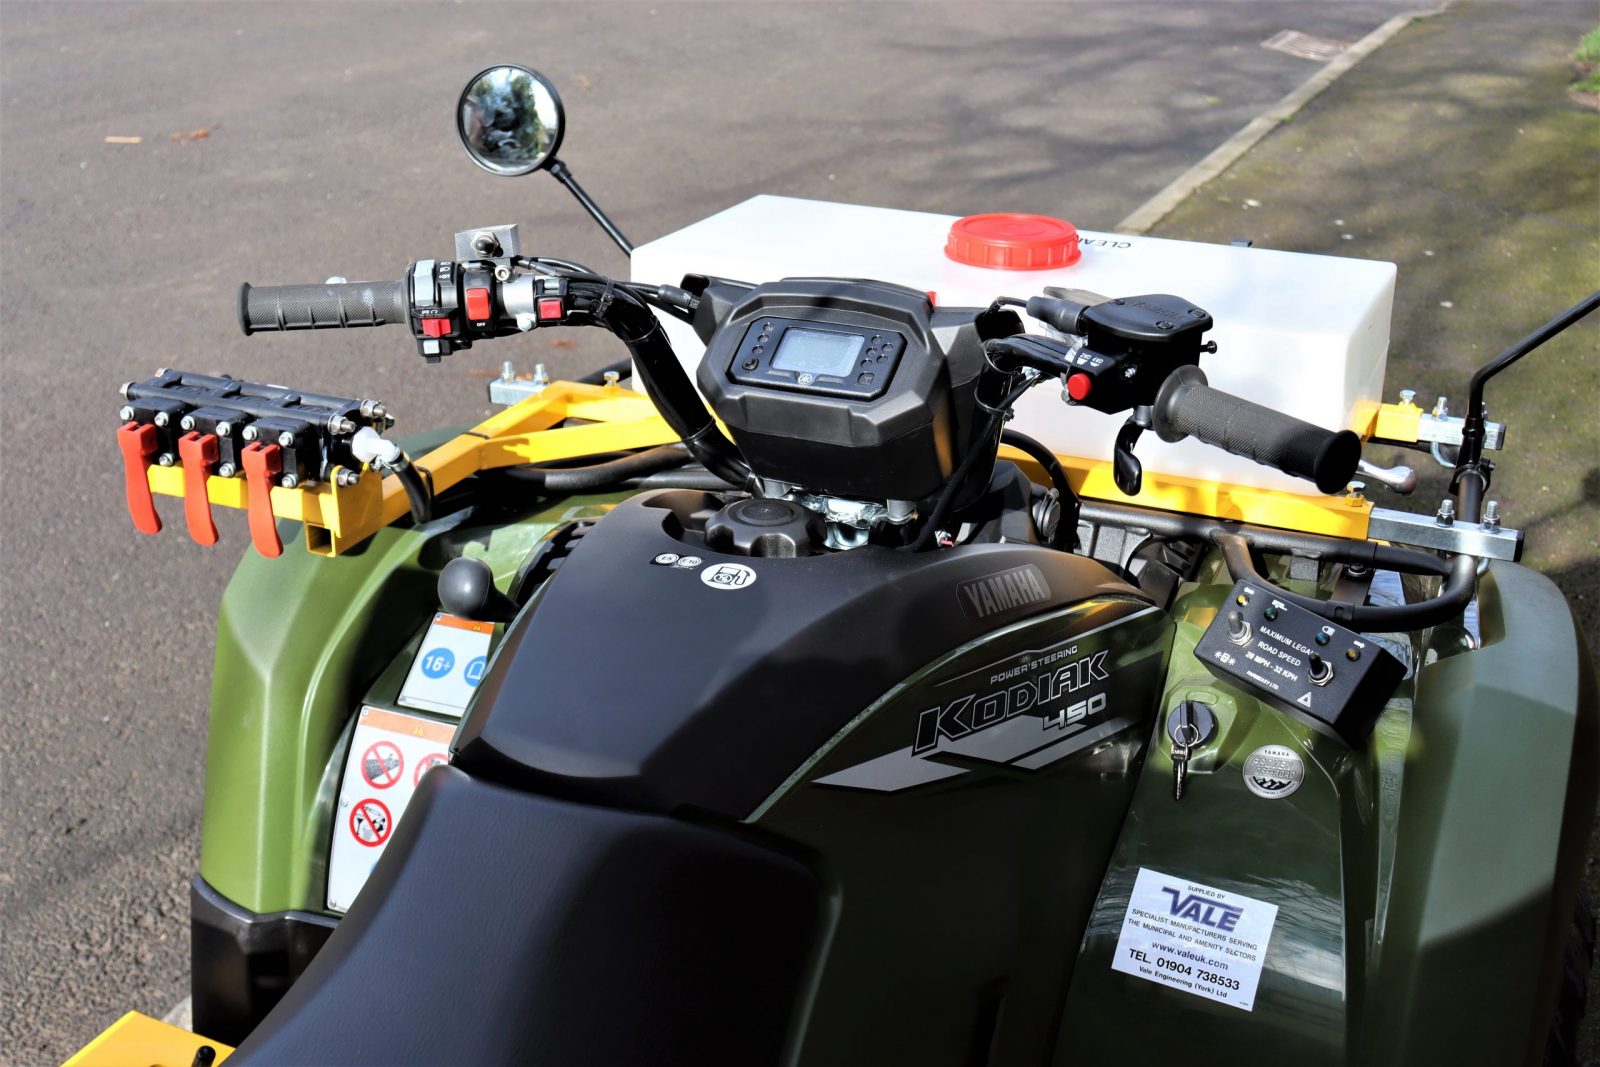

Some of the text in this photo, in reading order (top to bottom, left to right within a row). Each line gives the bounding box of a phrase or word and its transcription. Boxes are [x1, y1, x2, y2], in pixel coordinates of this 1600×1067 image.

[963, 568, 1047, 618] YAMAHA
[1258, 641, 1301, 667] ROAD SPEED
[1259, 625, 1319, 656] MAXIMUM LEGA
[425, 654, 451, 672] 16+
[990, 645, 1078, 685] POWER STEERING
[1253, 654, 1271, 668] MPH
[1273, 665, 1283, 674] 32
[1282, 669, 1298, 682] KPH
[911, 648, 1110, 757] KODIAK
[1042, 692, 1107, 731] 450
[1251, 757, 1294, 771] PROVEN
[1264, 749, 1290, 757] YAMAHA
[1187, 885, 1216, 897] SUPPLIED
[1161, 886, 1244, 933] VALE
[1127, 918, 1256, 961] THE MUNICIPAL AND AMENITY SECTORS
[1131, 908, 1258, 951] SPECIALIST MANUFACTURERS SERVING
[1129, 949, 1240, 991] TEL. 01904 738533
[1152, 942, 1228, 970] www.valeuk.com
[1139, 965, 1228, 998] Vale Engineering (York) Ltd
